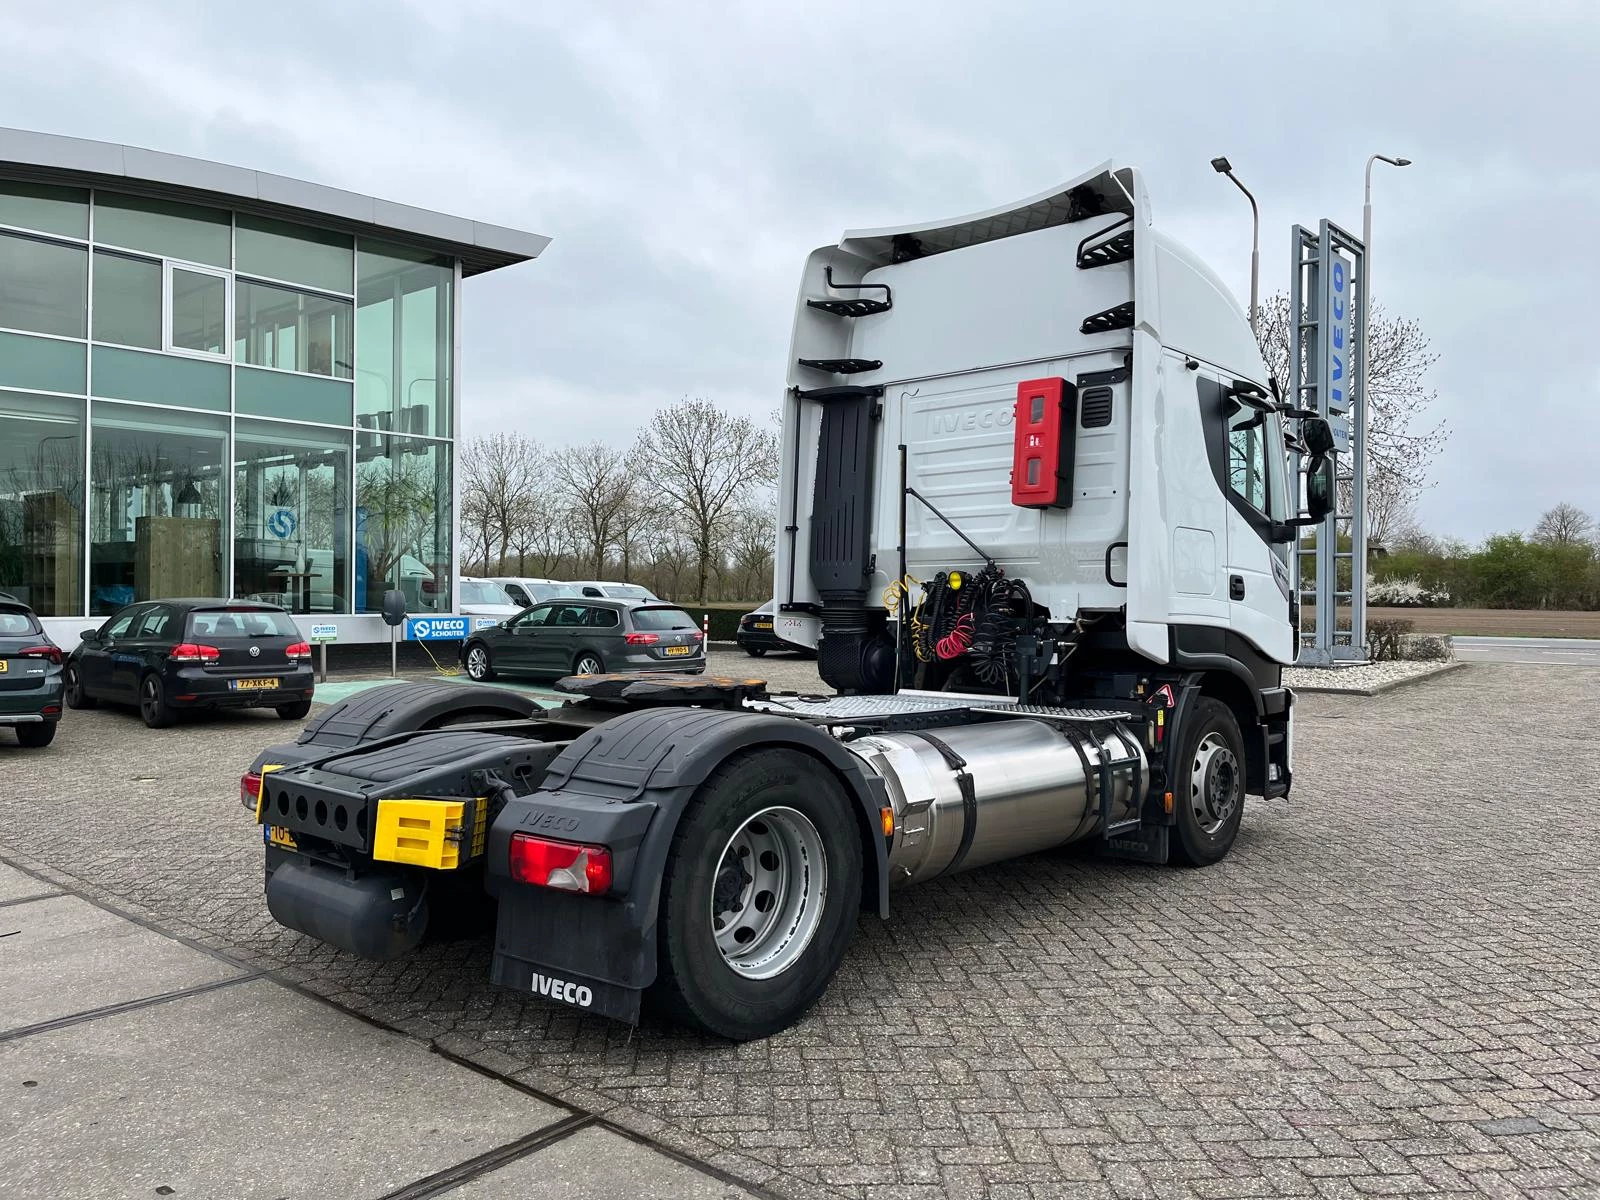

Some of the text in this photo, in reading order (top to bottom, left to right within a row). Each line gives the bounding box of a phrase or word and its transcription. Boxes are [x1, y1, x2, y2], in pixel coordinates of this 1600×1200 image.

[1332, 262, 1344, 402] IVECO
[933, 407, 1014, 434] IVECO
[1333, 428, 1348, 440] OUTEN
[431, 620, 464, 630] IVECO
[240, 680, 275, 688] 77-XKF-4
[520, 809, 580, 832] IVECO
[1109, 839, 1149, 852] IVECO
[531, 972, 593, 1007] IVECO
